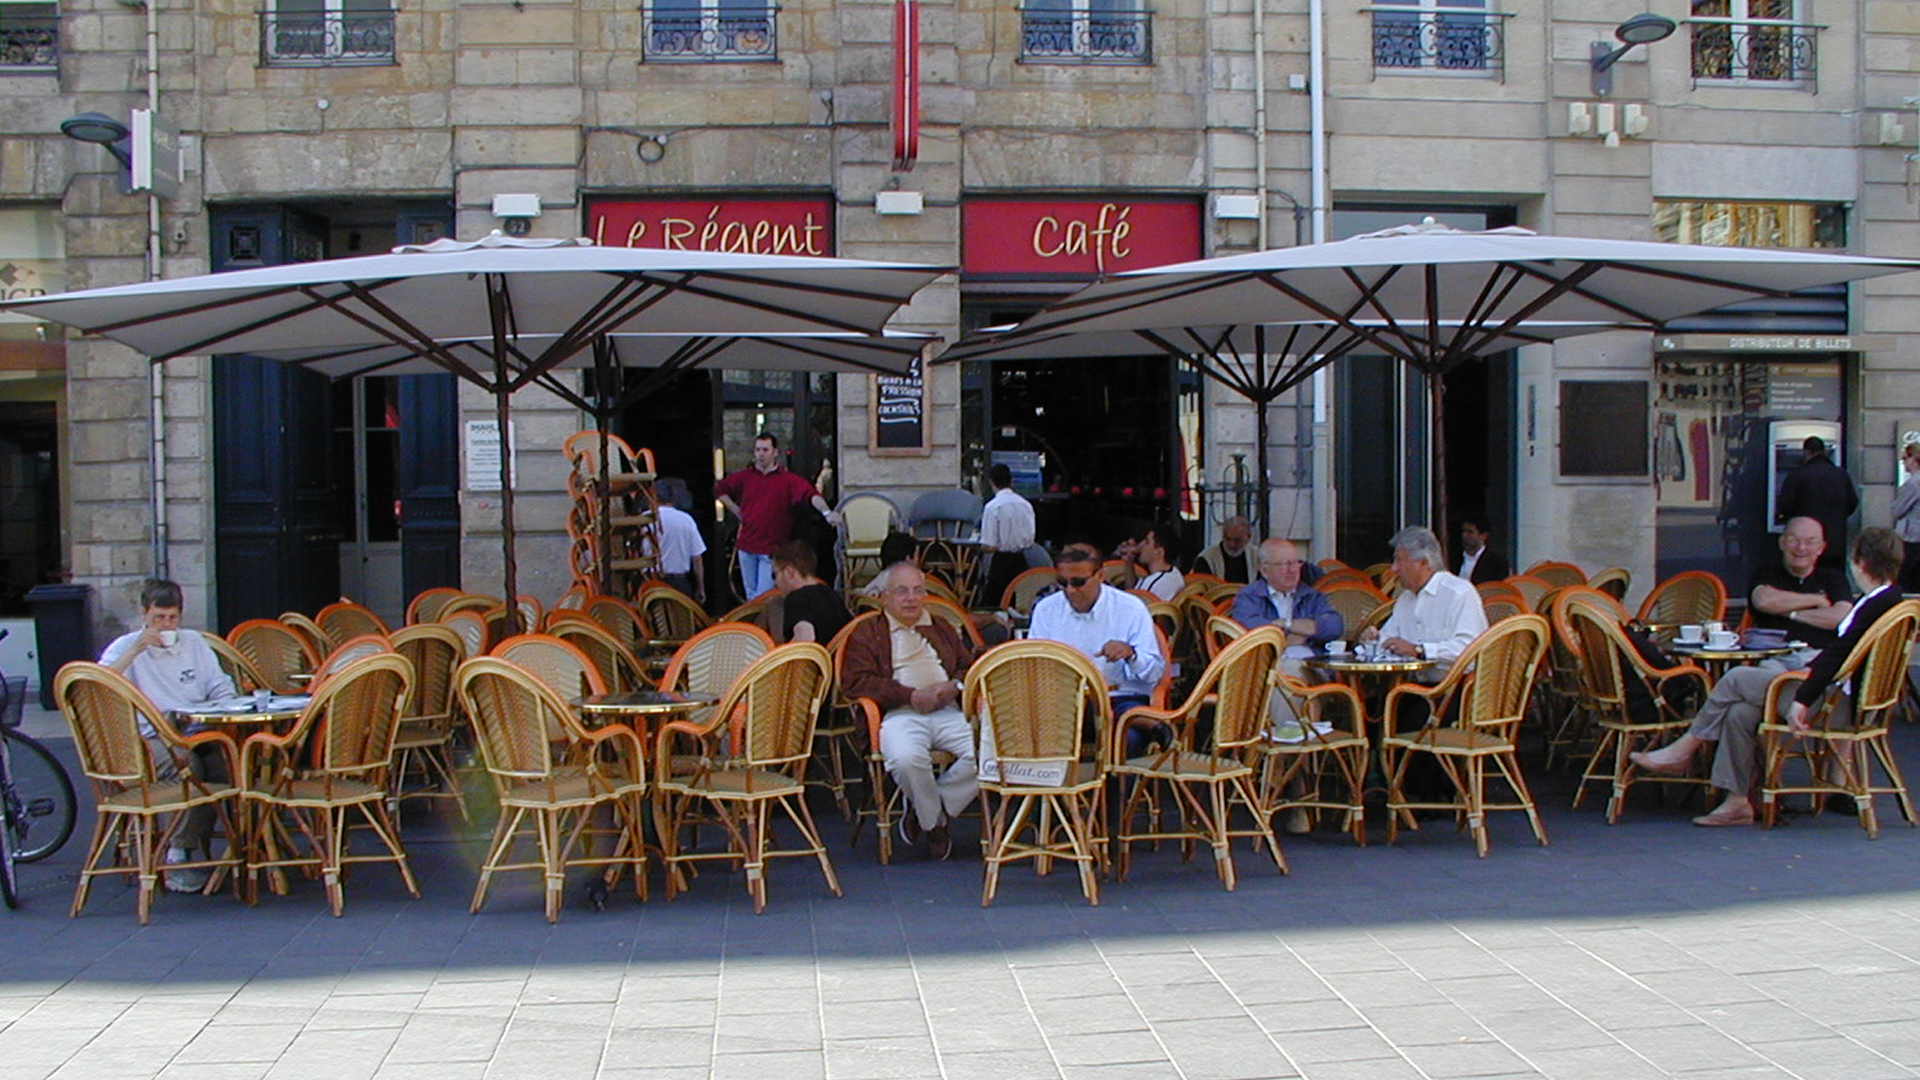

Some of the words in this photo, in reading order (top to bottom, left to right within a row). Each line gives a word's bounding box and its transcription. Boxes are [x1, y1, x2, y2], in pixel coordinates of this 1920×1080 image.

[1033, 202, 1132, 273] Café
[1729, 337, 1795, 349] DISTRIBUTEUR
[1798, 337, 1812, 349] DE
[1815, 338, 1852, 350] BILLETS
[881, 385, 922, 397] PRESSION
[878, 404, 921, 416] COCKTAILS
